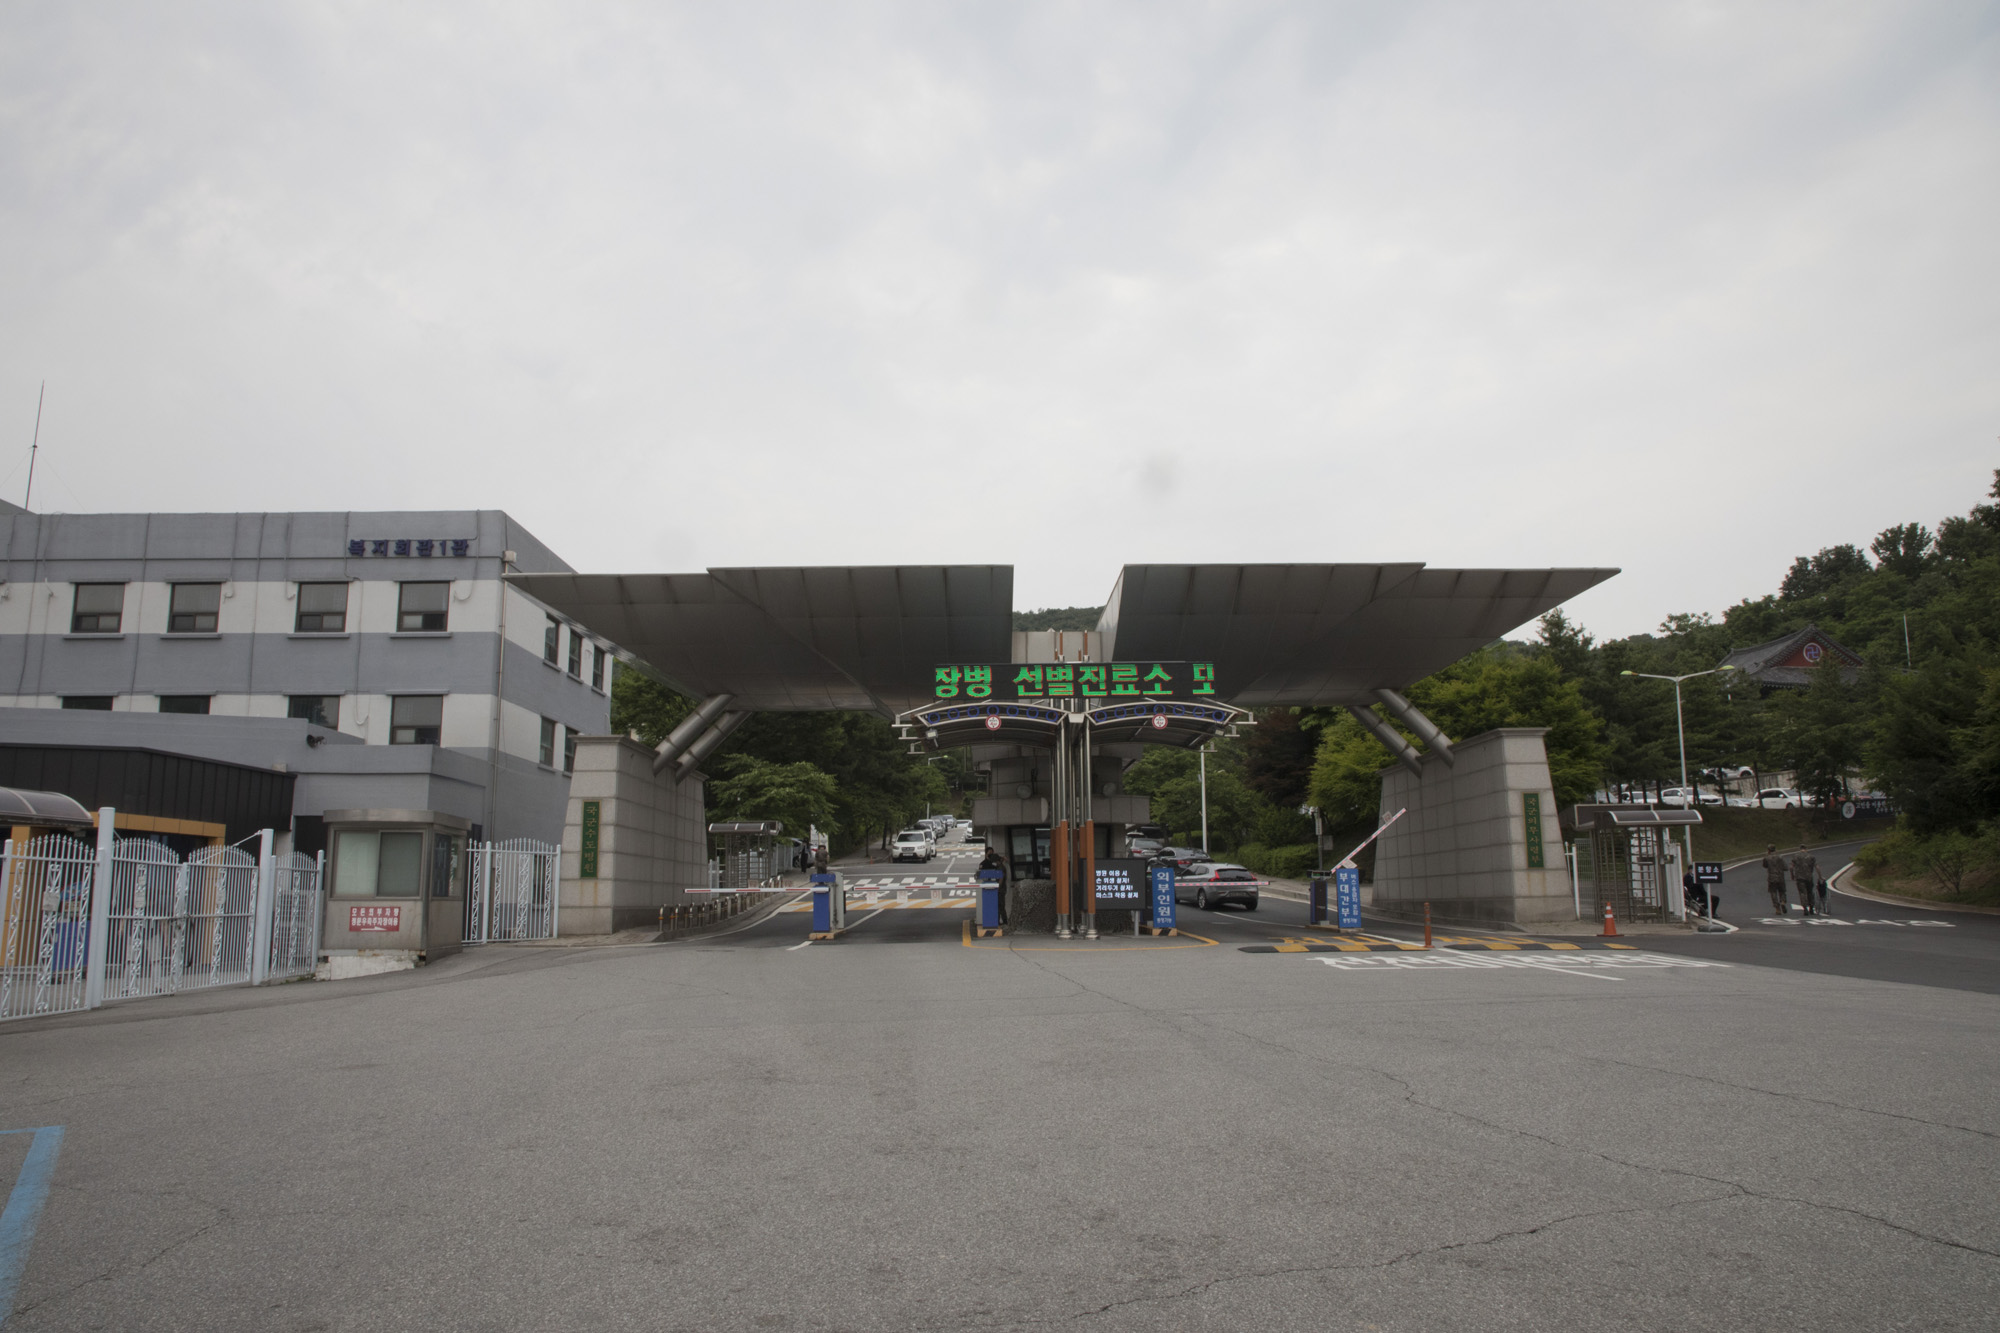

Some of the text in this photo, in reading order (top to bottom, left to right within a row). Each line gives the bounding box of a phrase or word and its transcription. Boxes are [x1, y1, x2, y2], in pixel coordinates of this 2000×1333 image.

[935, 665, 992, 698] 장병
[1013, 664, 1173, 696] 선별진료소
[584, 805, 597, 873] 국군수도병원
[1157, 872, 1171, 916] 외부인원
[1339, 873, 1350, 917] 부대간부
